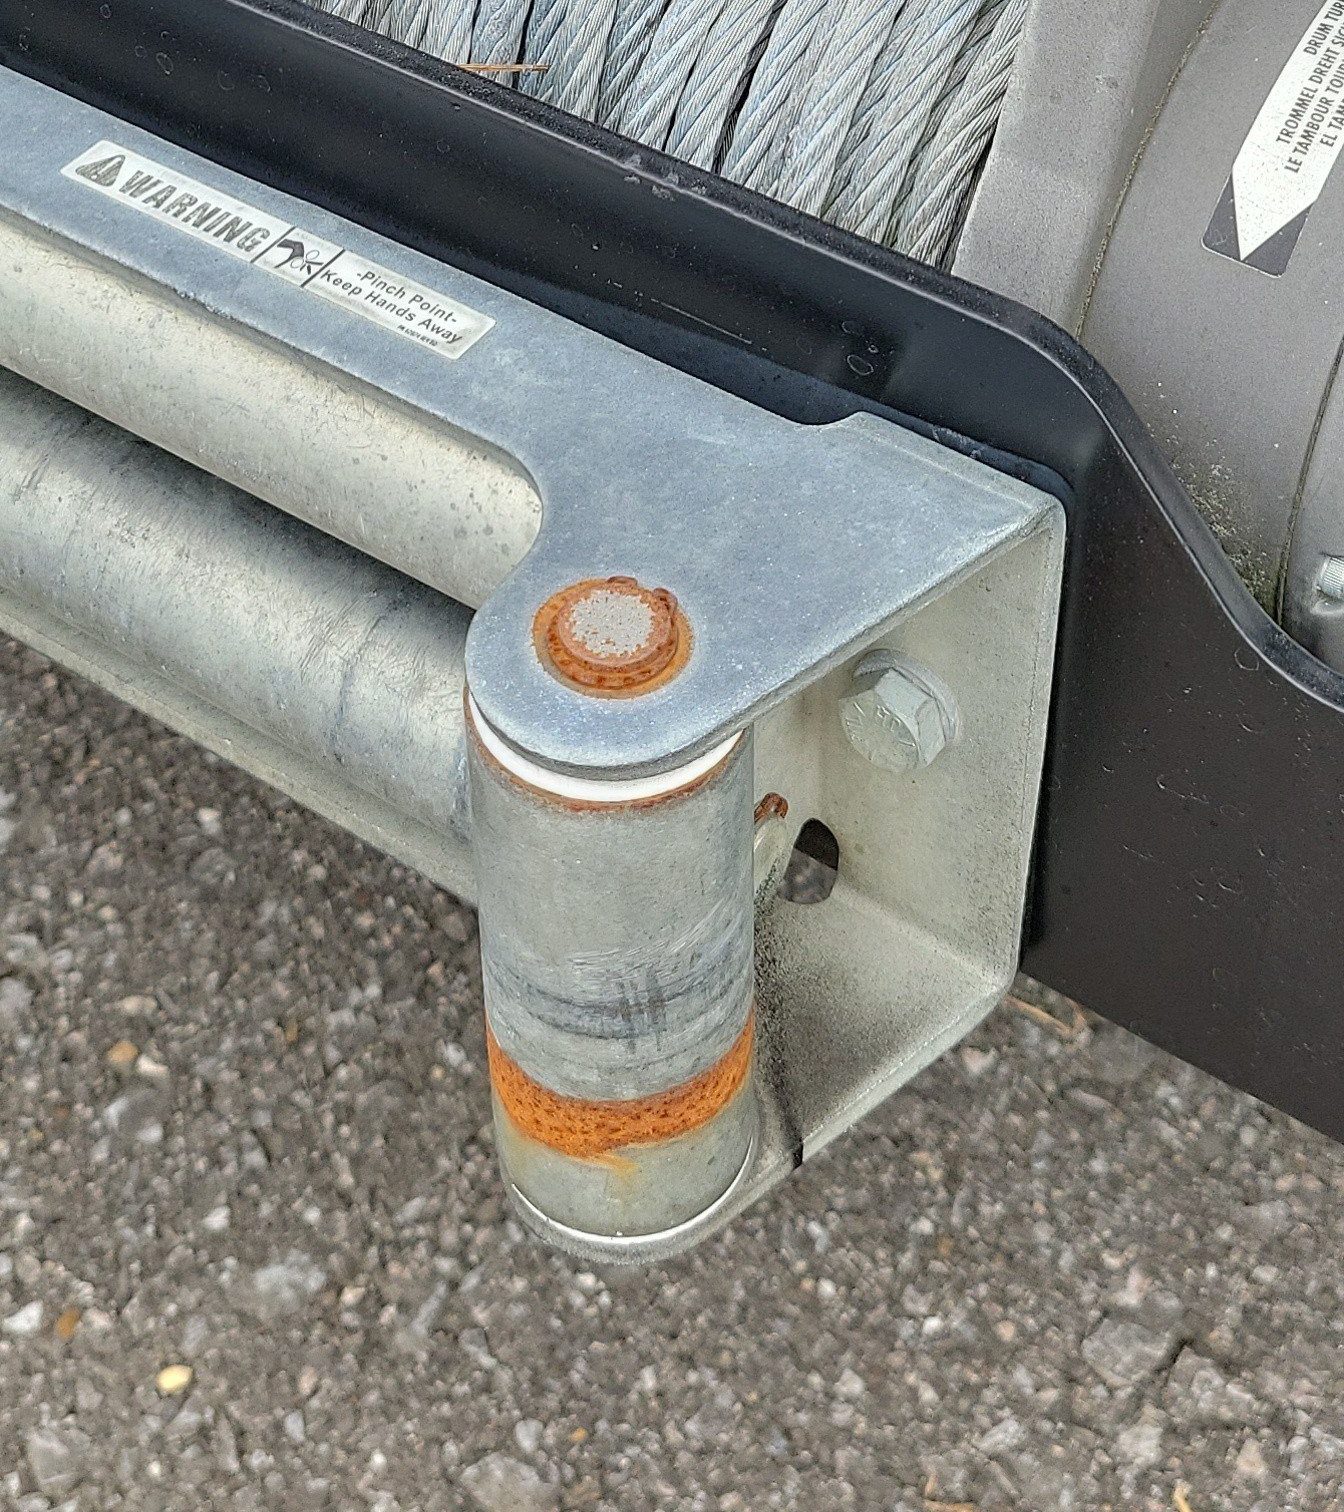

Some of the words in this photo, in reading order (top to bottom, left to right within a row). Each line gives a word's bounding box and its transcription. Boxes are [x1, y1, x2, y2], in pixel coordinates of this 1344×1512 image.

[1303, 22, 1334, 55] DRUM
[1276, 86, 1318, 145] TROMMEL
[1308, 47, 1340, 85] DREHT
[1292, 96, 1335, 156] TAMBOUR
[1284, 156, 1303, 174] LE
[1320, 133, 1338, 148] EL
[117, 169, 270, 255] WARNING
[320, 269, 363, 297] Keep
[364, 290, 417, 322] Hands
[418, 318, 463, 345] Away
